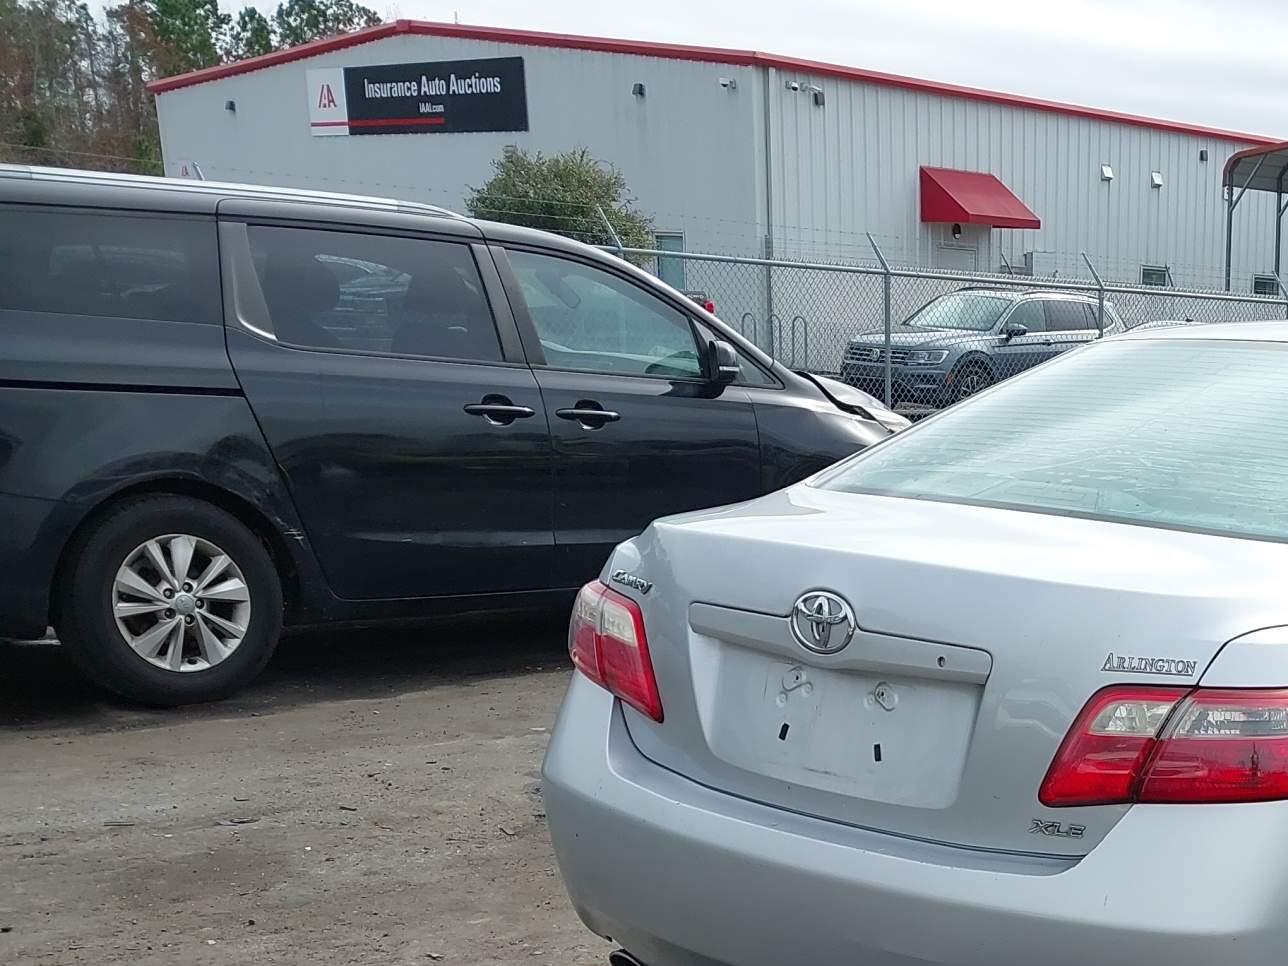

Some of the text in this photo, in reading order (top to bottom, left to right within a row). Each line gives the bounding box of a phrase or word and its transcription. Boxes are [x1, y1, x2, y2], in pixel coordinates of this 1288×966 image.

[364, 72, 501, 98] Insurance Auto Auctions
[612, 569, 653, 595] CAMRY
[1101, 652, 1197, 675] ARLINGTON
[1029, 819, 1086, 838] XLE
